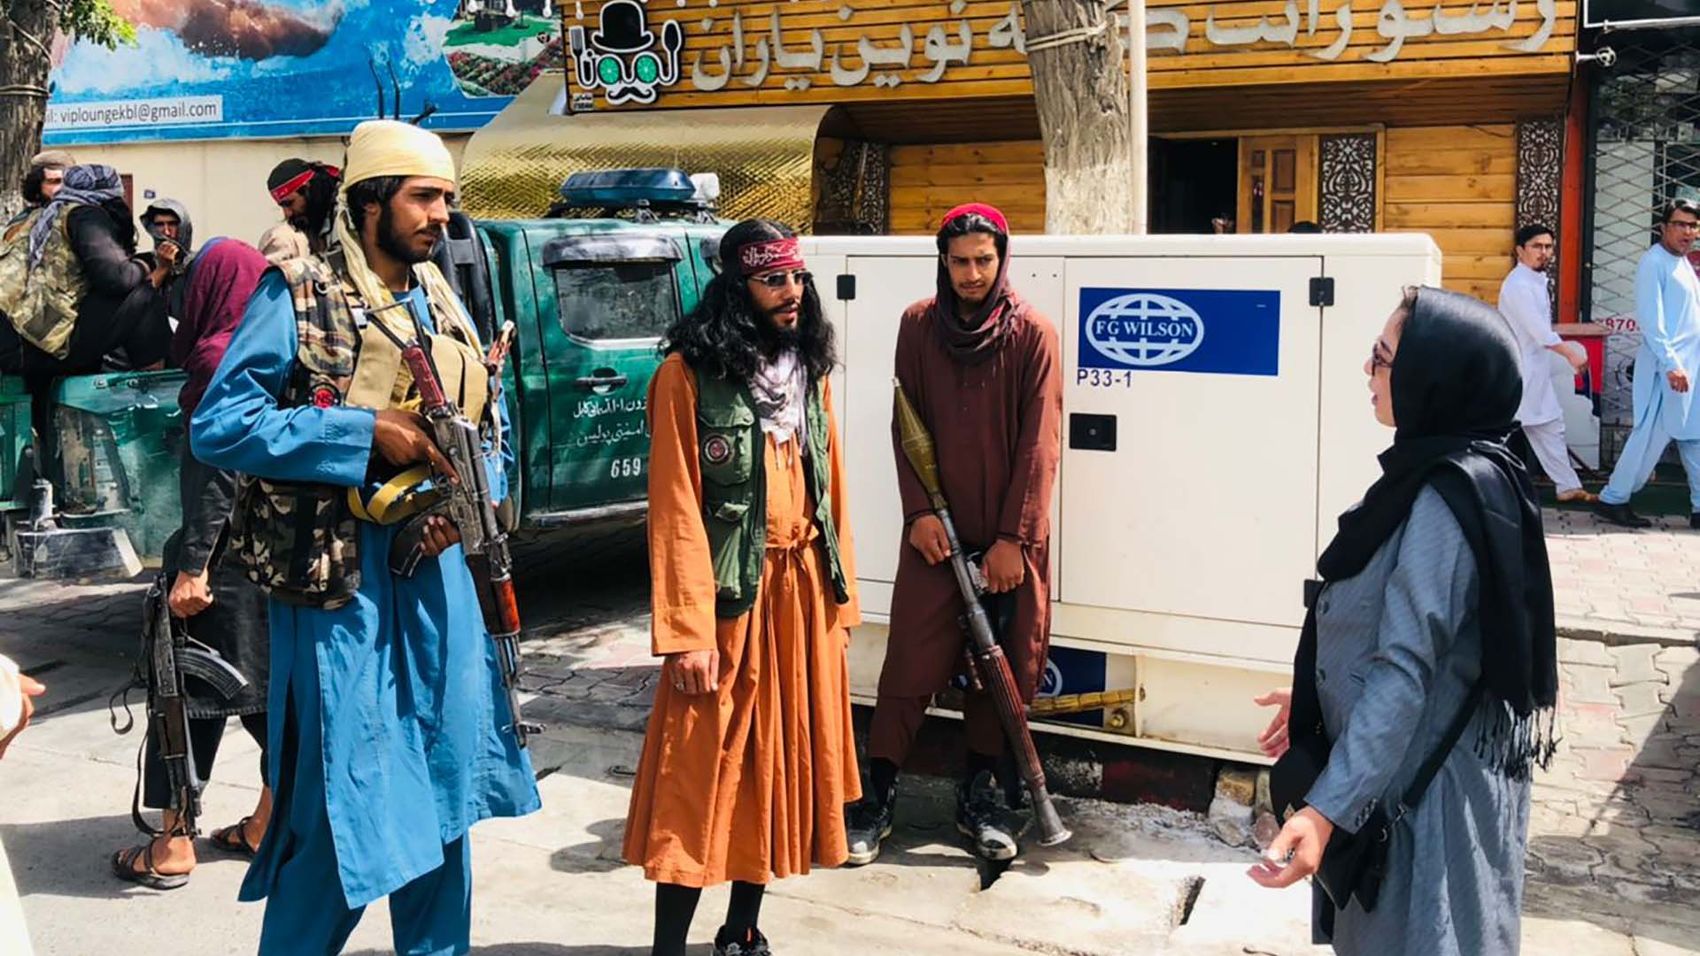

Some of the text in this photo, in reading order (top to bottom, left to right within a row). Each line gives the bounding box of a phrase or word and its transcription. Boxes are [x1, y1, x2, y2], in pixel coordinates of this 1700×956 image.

[60, 102, 217, 125] viploungekbl@gmail.com
[1095, 320, 1194, 337] FG WILSON
[1077, 369, 1132, 387] P33-1
[611, 457, 641, 478] 659
